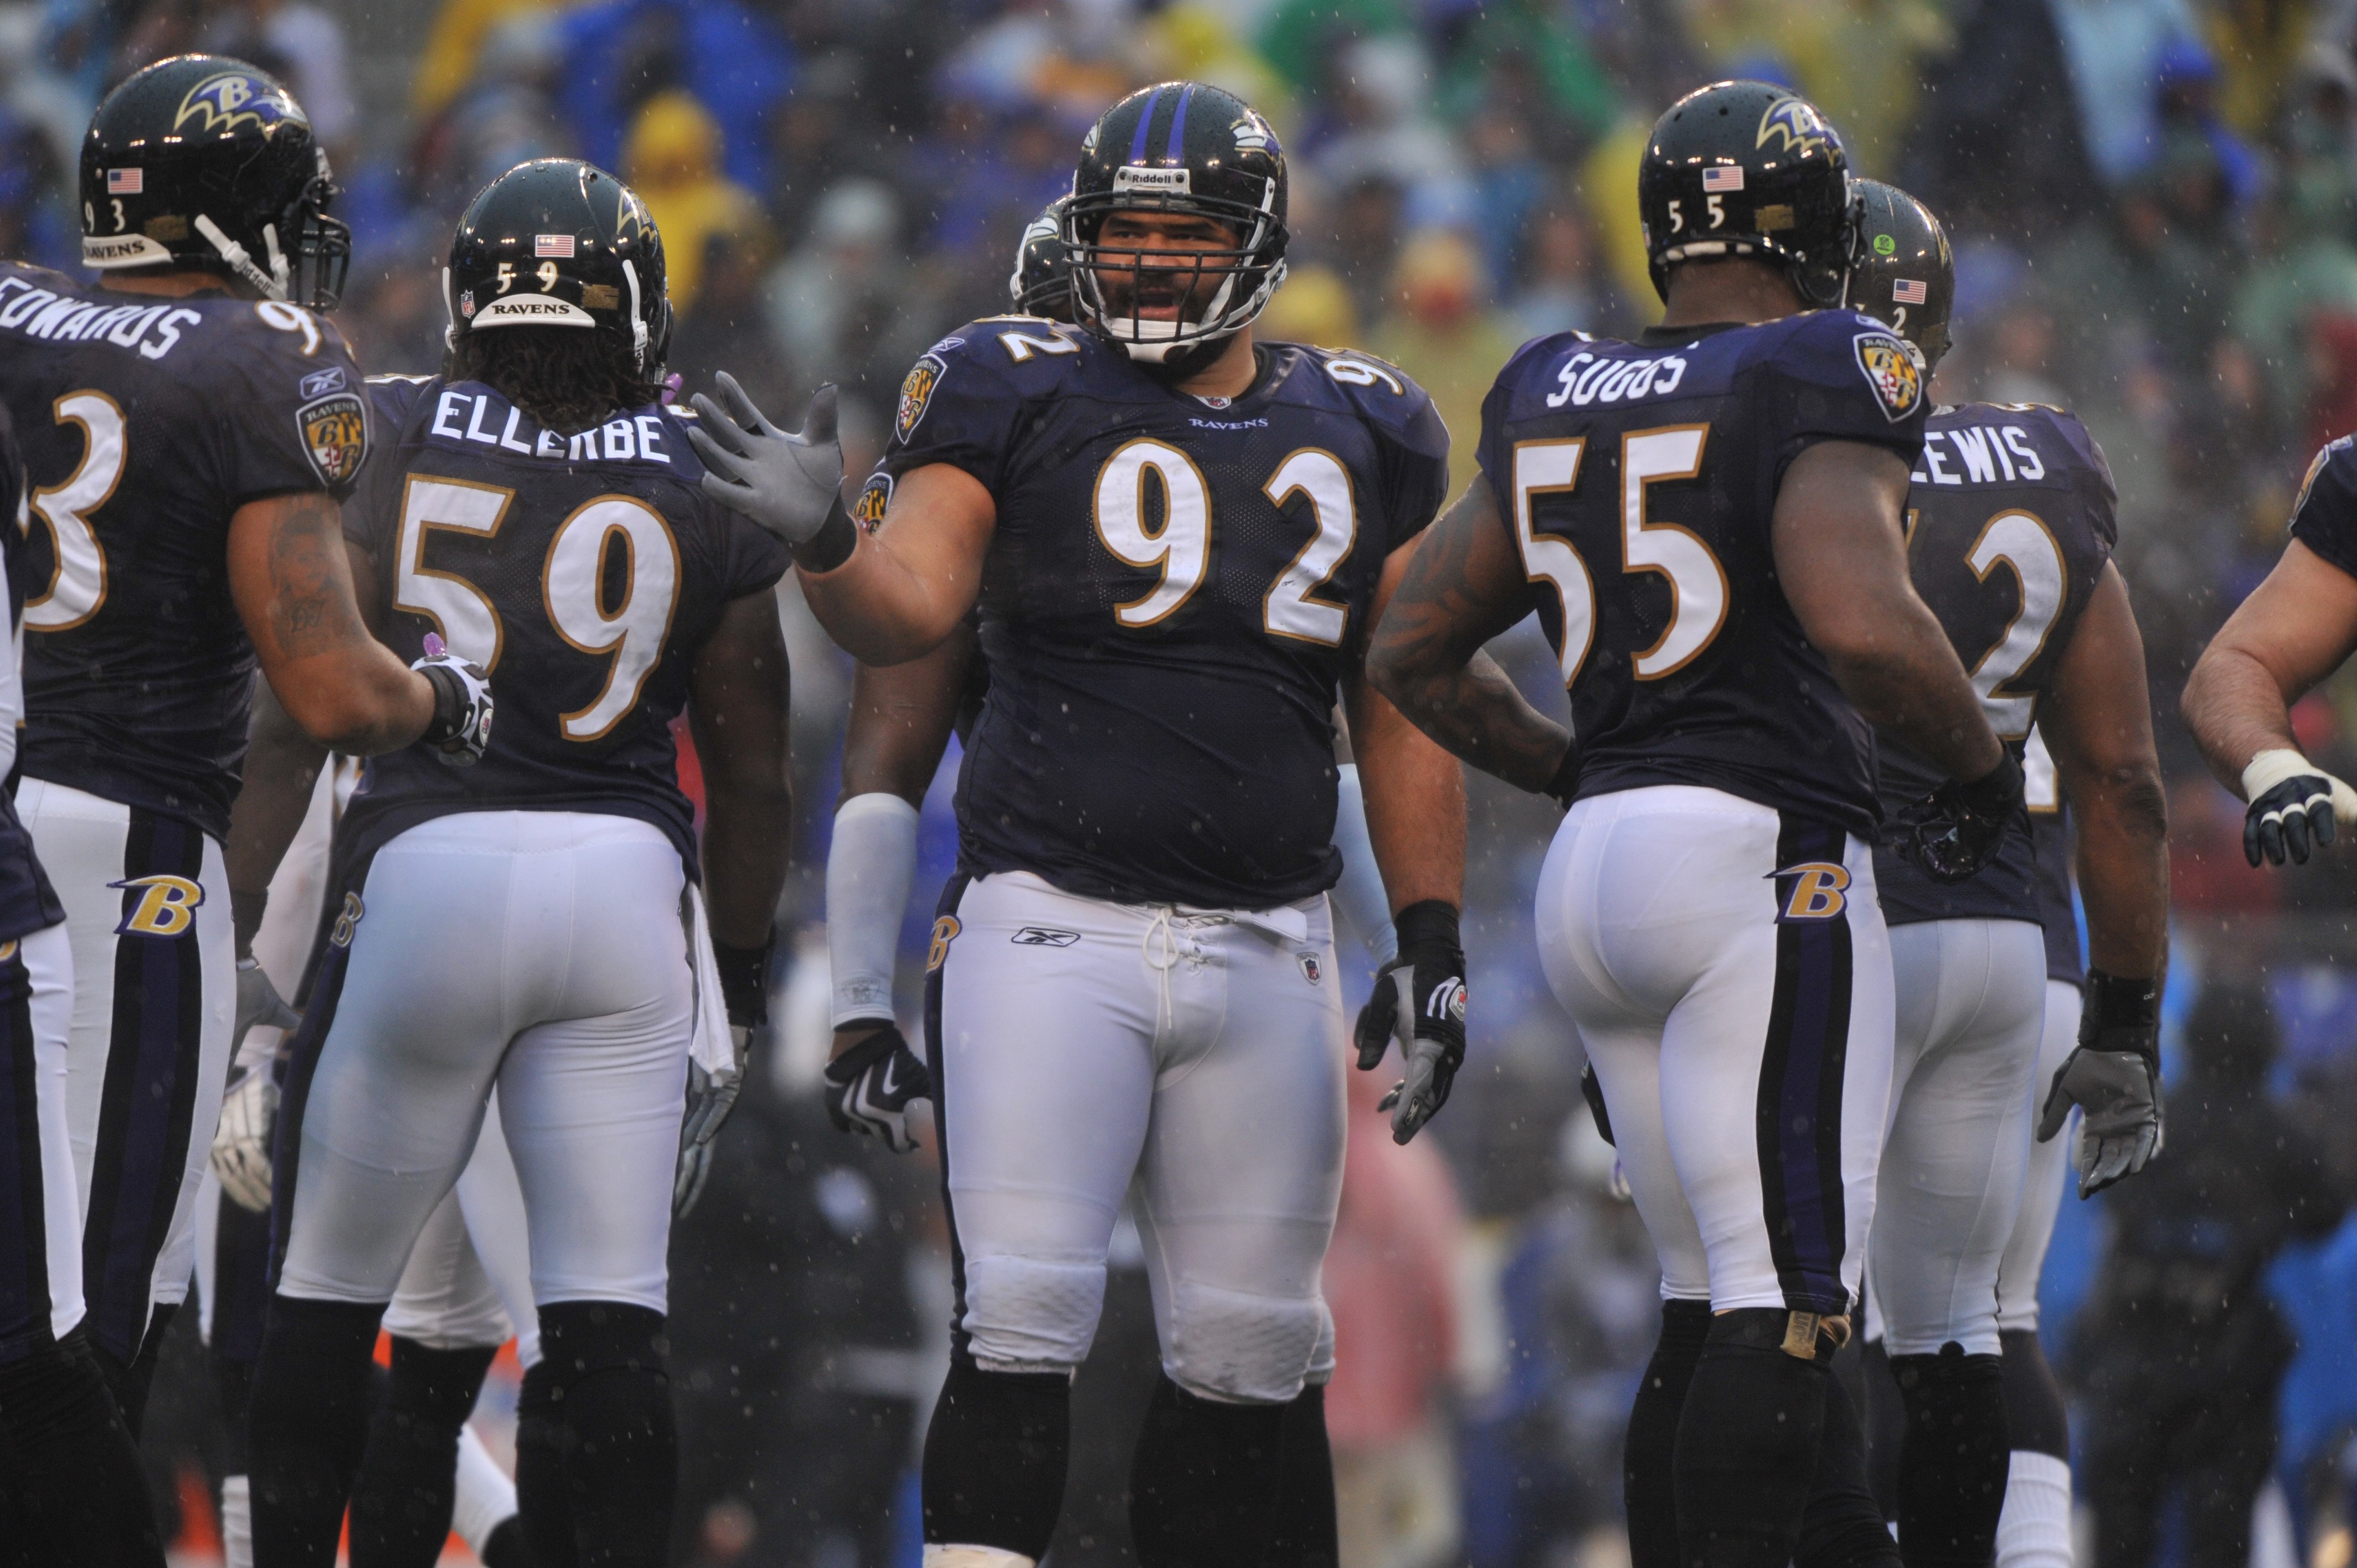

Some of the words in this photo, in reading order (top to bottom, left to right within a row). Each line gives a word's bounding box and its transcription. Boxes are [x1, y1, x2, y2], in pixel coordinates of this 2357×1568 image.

[1133, 174, 1171, 184] Riddell
[85, 198, 125, 234] 93
[1668, 194, 1725, 234] 55
[496, 261, 558, 294] 59
[492, 304, 570, 316] RAVENS
[1546, 341, 1699, 408] SUGGS
[306, 401, 358, 422] RAVENS
[430, 391, 670, 463] ELLERBE
[1188, 418, 1268, 430] RAVENS
[17, 389, 128, 632] 3
[1092, 437, 1356, 647] 92
[1512, 422, 1730, 690] 55
[393, 472, 682, 742] 59
[1905, 508, 2067, 741] 2
